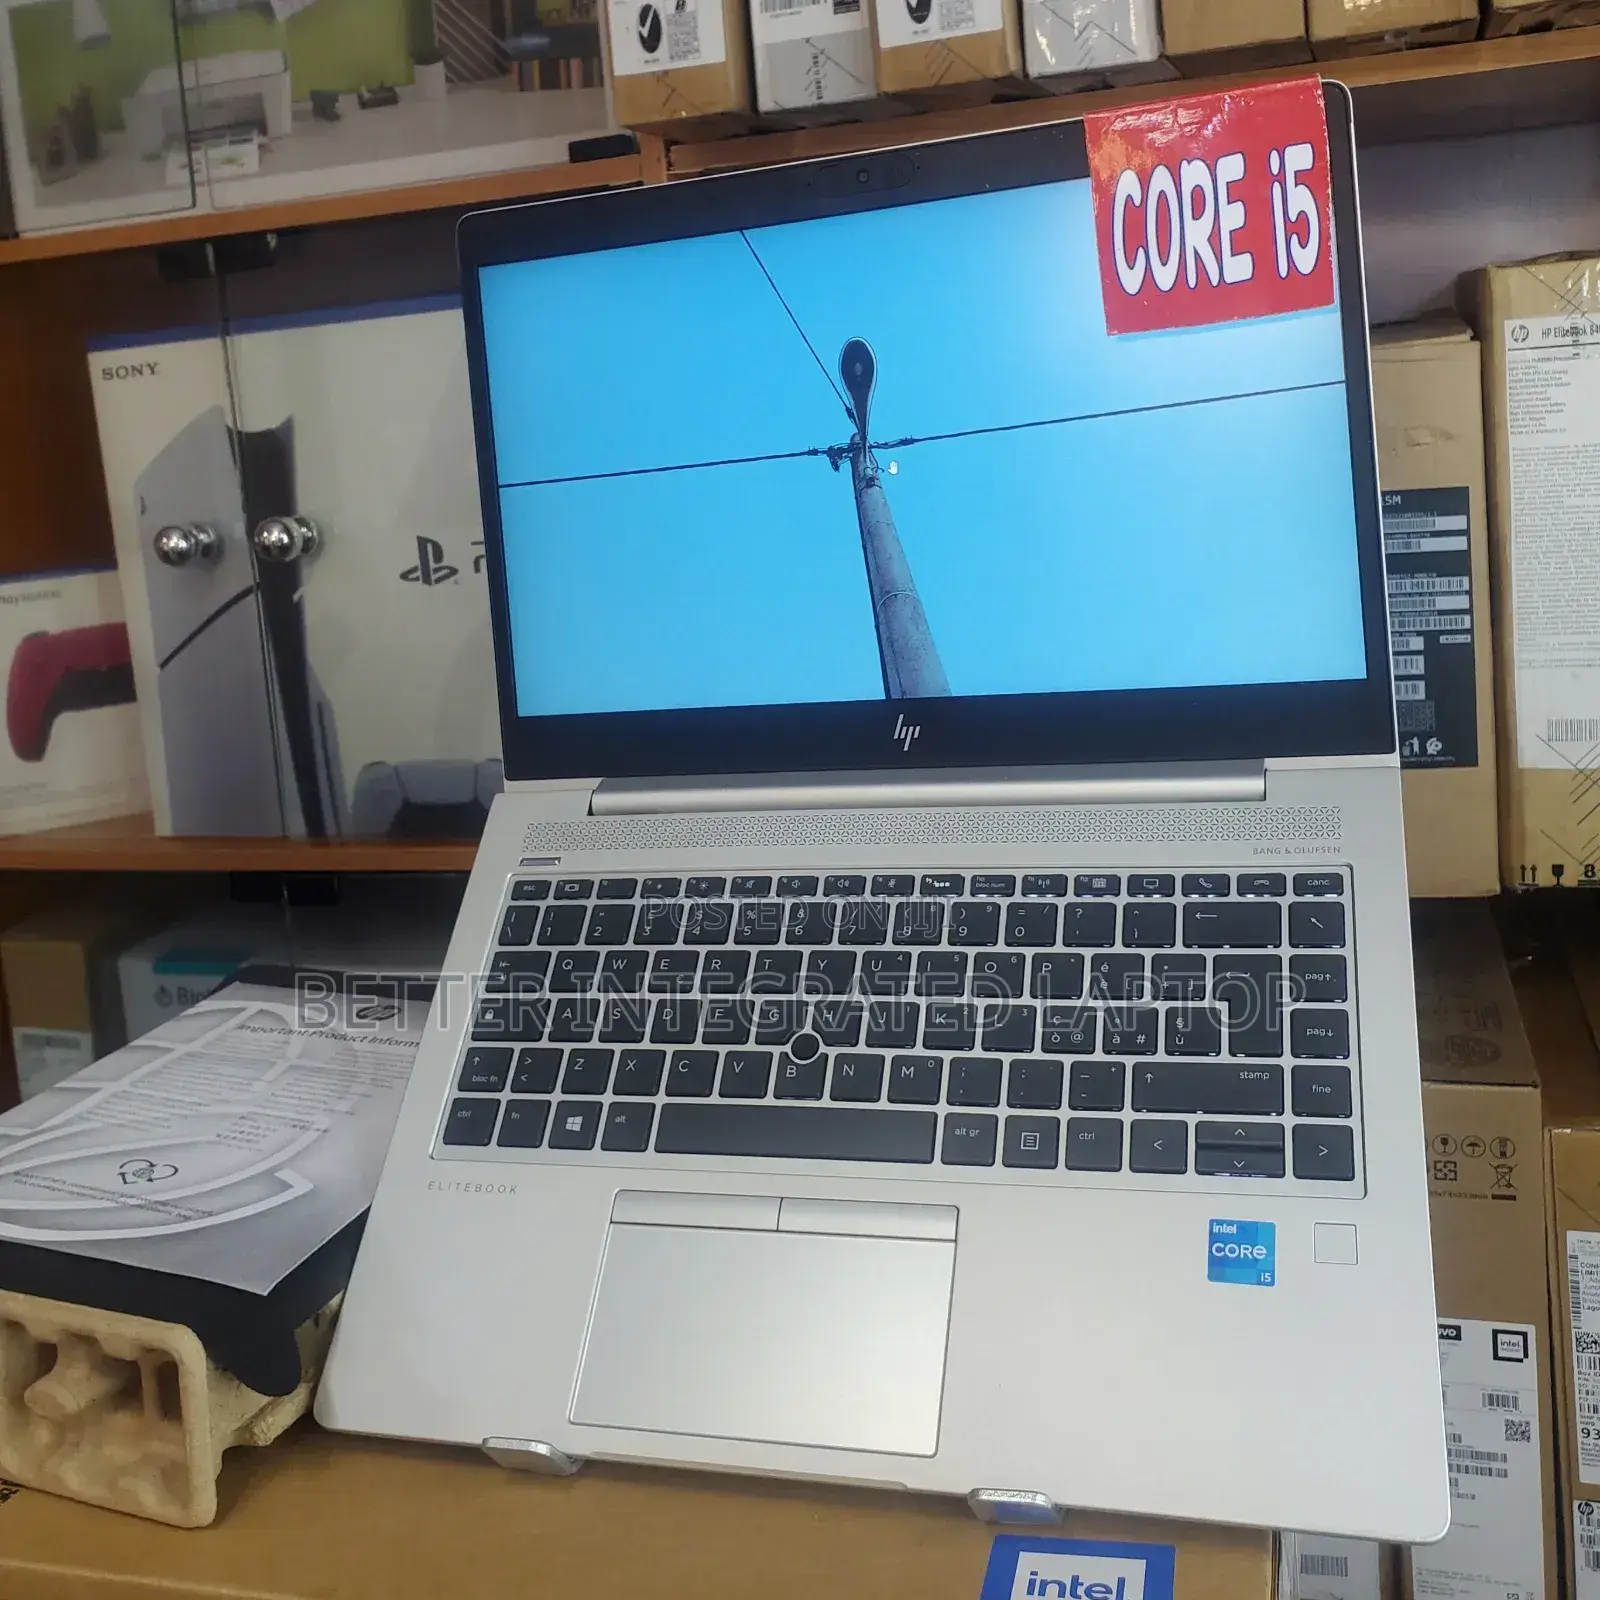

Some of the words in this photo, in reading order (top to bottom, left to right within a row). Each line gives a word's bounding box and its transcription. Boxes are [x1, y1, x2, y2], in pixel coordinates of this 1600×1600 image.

[1113, 151, 1254, 296] CORE
[1268, 142, 1320, 279] i5
[1541, 327, 1551, 339] HP
[101, 362, 160, 380] SONY
[893, 714, 920, 751] hp
[1252, 847, 1281, 855] BANG
[1307, 878, 1330, 886] canc
[1075, 908, 1083, 917] ?
[594, 927, 602, 936] 2
[643, 926, 650, 936] 3
[692, 926, 700, 935] 4
[743, 926, 751, 935] 5
[795, 926, 803, 935] 6
[849, 926, 856, 935] 7
[959, 926, 968, 936] 9
[562, 959, 573, 971] Q
[612, 959, 627, 970] W
[660, 958, 670, 970] E
[711, 959, 722, 970] R
[764, 959, 772, 970] T
[817, 960, 828, 970] Y
[871, 960, 882, 971] U
[1041, 962, 1052, 974] P
[1305, 972, 1324, 981] pag
[562, 1008, 572, 1019] A
[612, 1008, 622, 1019] S
[662, 1008, 673, 1020] D
[714, 1009, 724, 1020] F
[769, 1009, 780, 1021] G
[822, 1010, 833, 1022] H
[879, 1012, 886, 1024] J
[935, 1013, 947, 1025] K
[995, 1015, 1003, 1027] L
[237, 1024, 307, 1038] Important
[308, 1030, 369, 1043] Product
[1071, 1032, 1084, 1043] @
[1306, 1028, 1326, 1037] pag
[1136, 1034, 1146, 1044] #
[574, 1058, 586, 1070] Z
[625, 1059, 637, 1071] X
[678, 1060, 690, 1072] C
[733, 1061, 744, 1073] V
[786, 1065, 797, 1077] B
[842, 1064, 854, 1076] N
[901, 1066, 915, 1078] M
[1239, 1070, 1270, 1080] stamp
[1312, 1084, 1332, 1094] fine
[457, 1110, 471, 1118] ctrl
[511, 1111, 520, 1119] fn
[614, 1115, 626, 1123] alt
[954, 1127, 967, 1136] alt
[969, 1127, 980, 1137] gr
[1078, 1132, 1095, 1140] ctrl
[427, 1181, 518, 1195] ELITEBOOK
[1212, 1222, 1237, 1234] intel
[1260, 1272, 1272, 1282] i5
[1500, 1339, 1521, 1348] intel
[1026, 1571, 1126, 1600] intel
